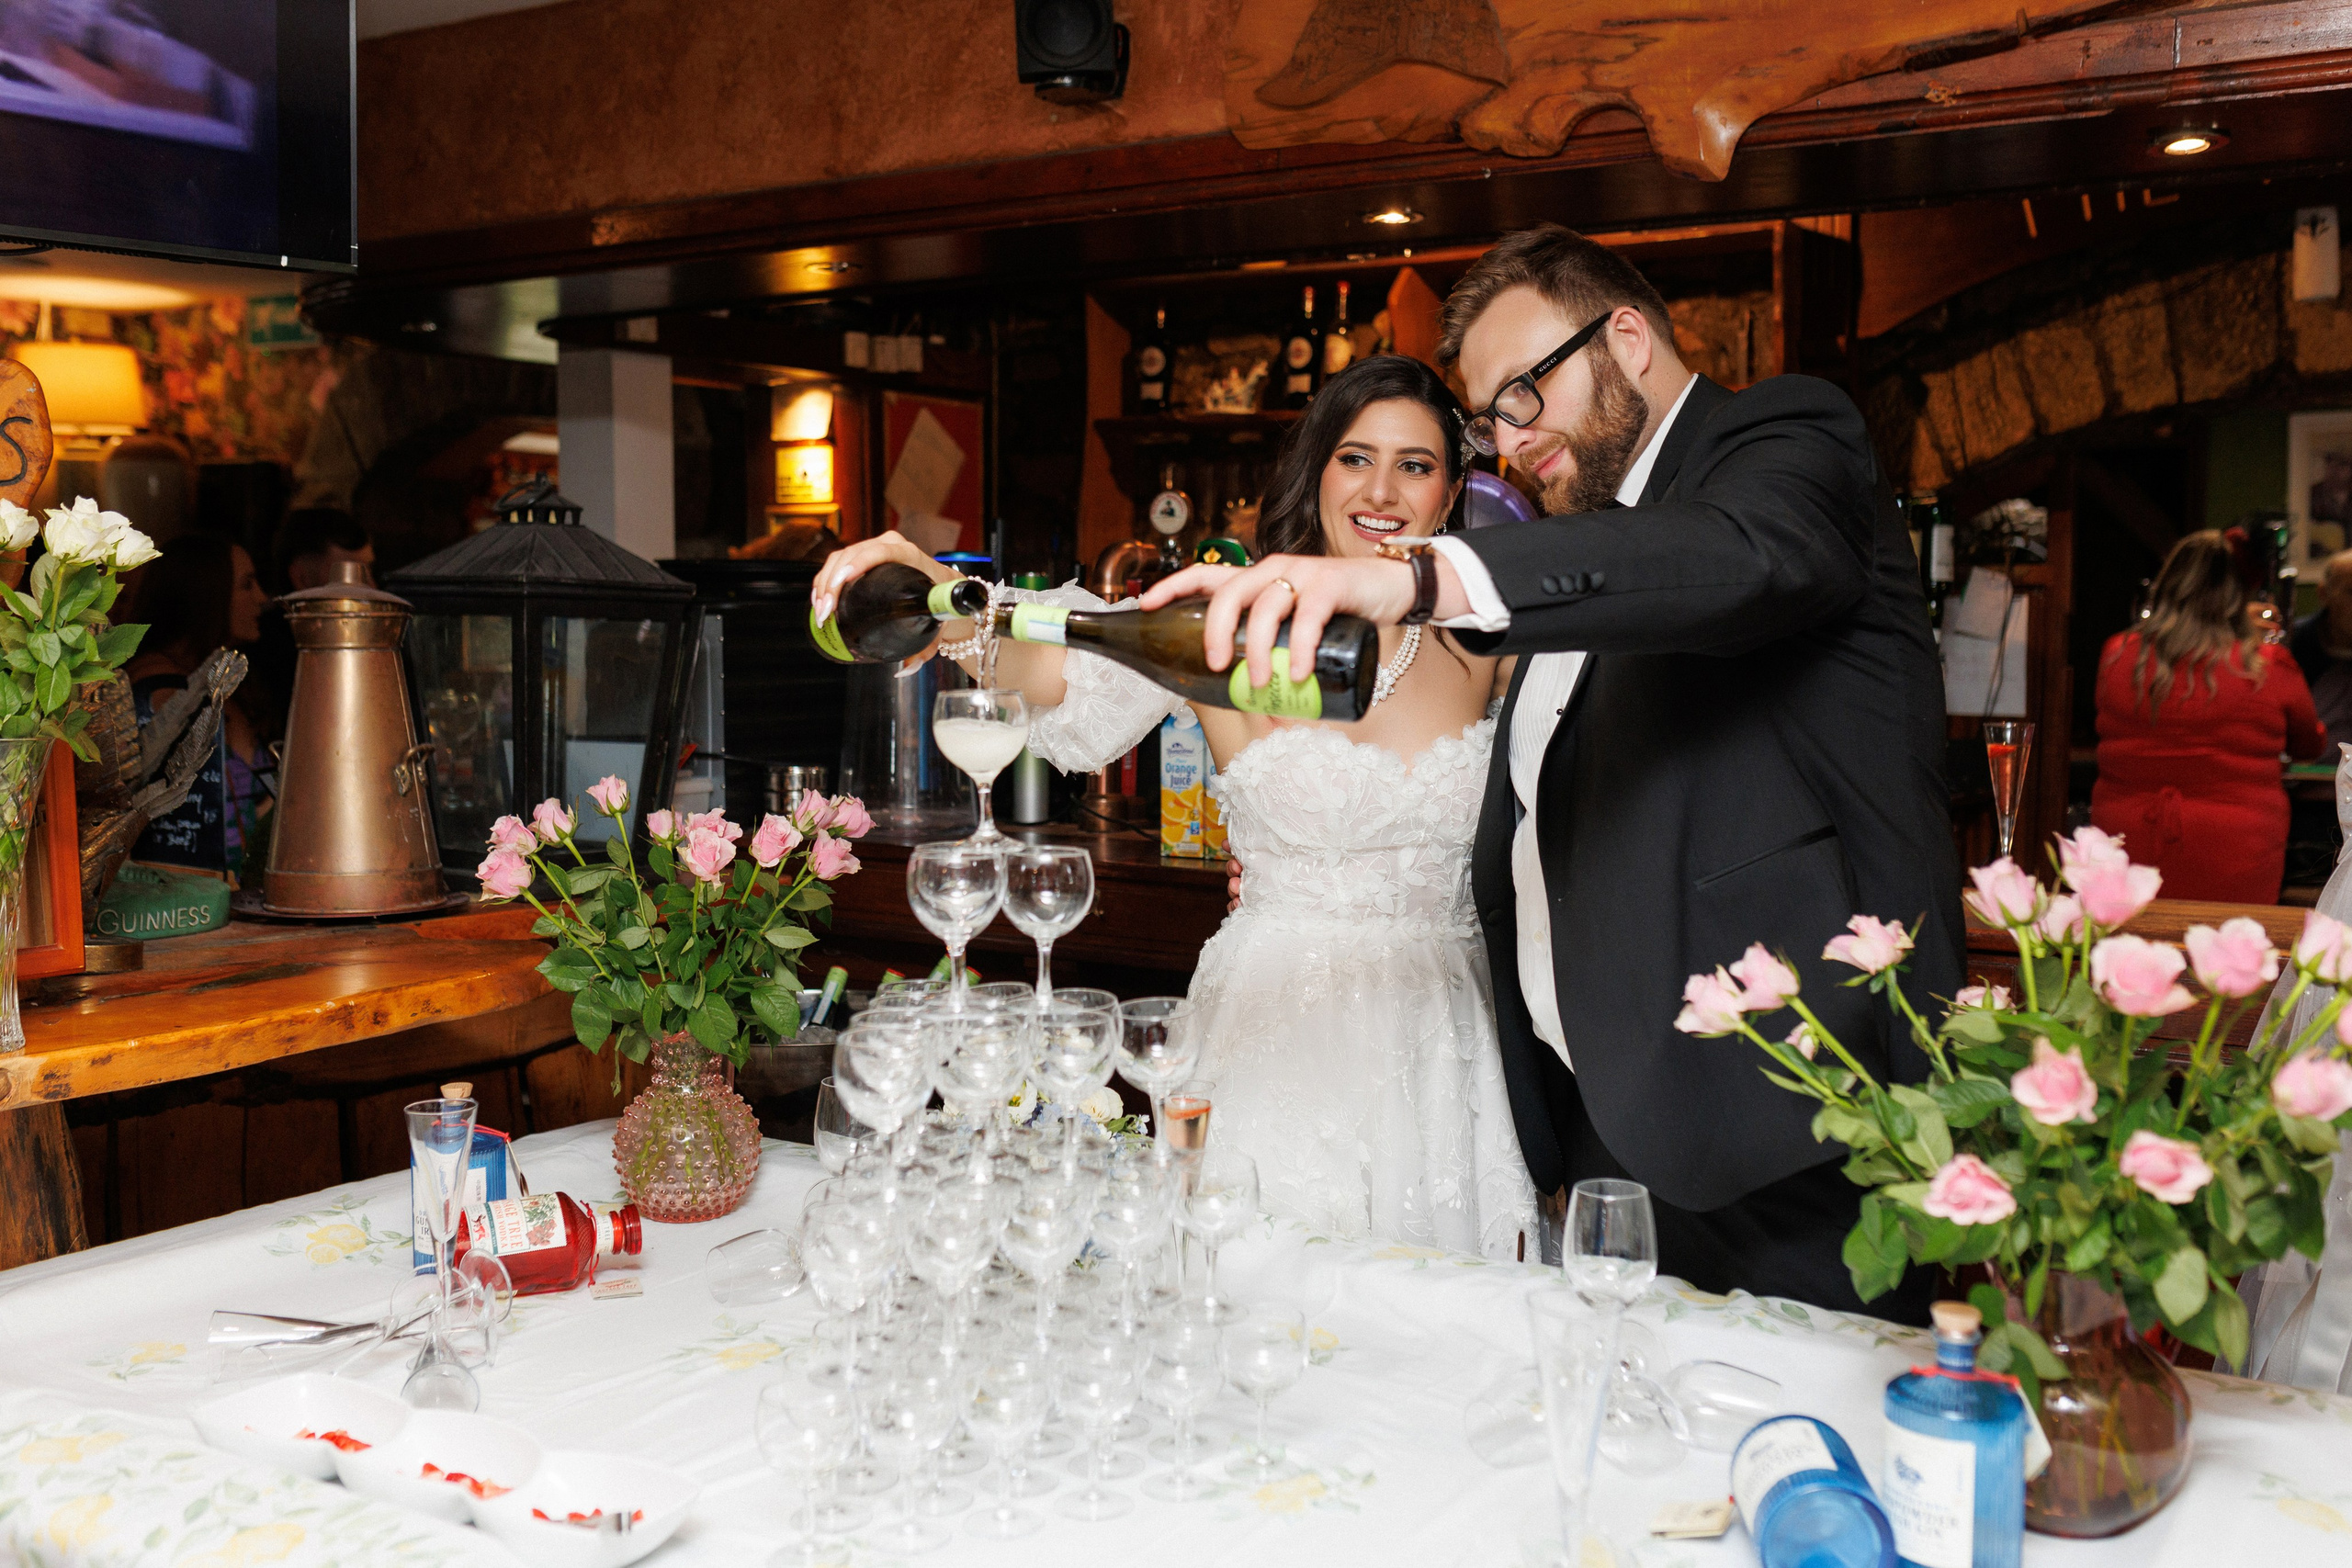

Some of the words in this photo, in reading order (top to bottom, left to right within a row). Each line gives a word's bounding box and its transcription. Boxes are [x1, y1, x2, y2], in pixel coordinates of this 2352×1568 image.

[1539, 356, 1557, 372] GUCCI
[1165, 762, 1197, 777] Orange
[1170, 773, 1192, 788] Juice
[96, 905, 210, 935] GUINNESS
[498, 1220, 508, 1249] VODKA
[507, 1220, 524, 1249] TREE
